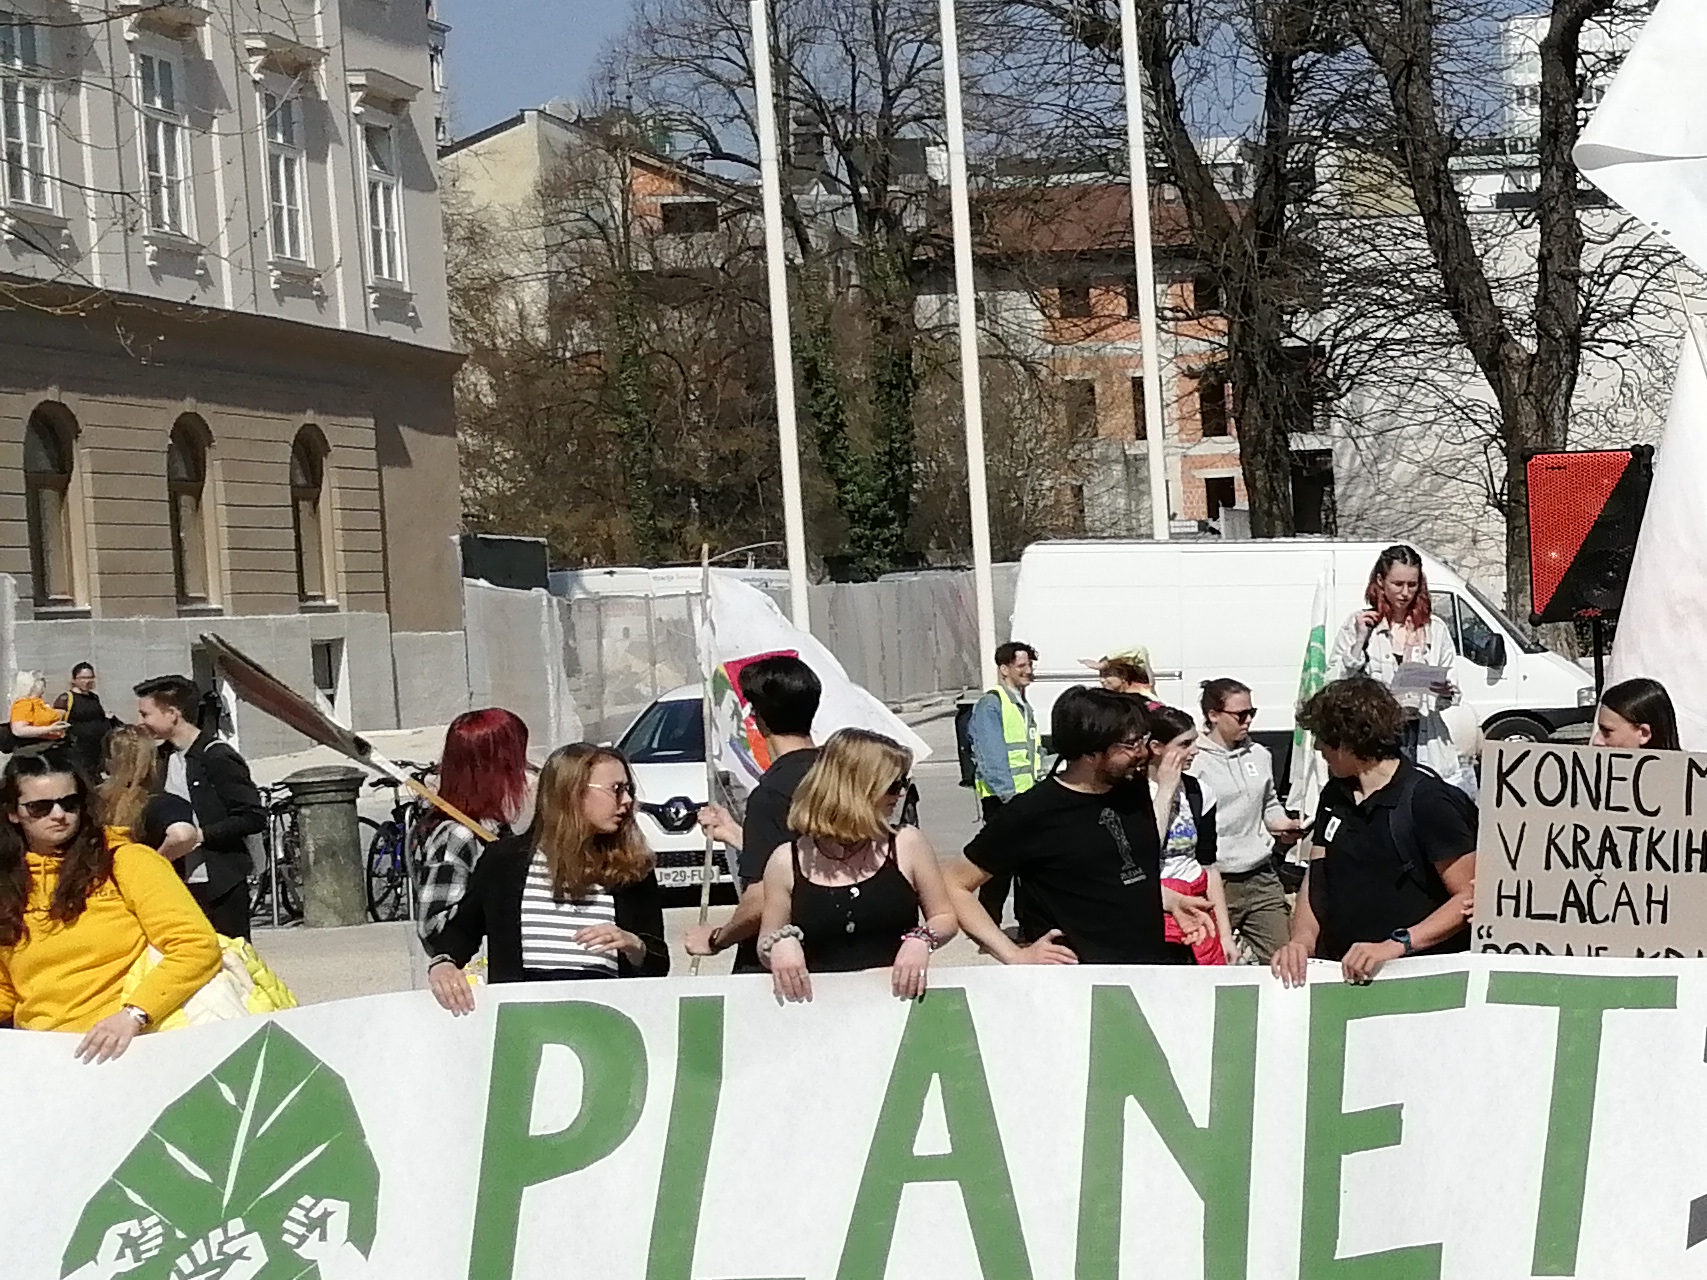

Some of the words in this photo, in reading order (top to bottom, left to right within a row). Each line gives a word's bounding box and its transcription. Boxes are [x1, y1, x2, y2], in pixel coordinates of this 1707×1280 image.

[1494, 747, 1661, 818] KONEC
[1497, 821, 1527, 871] V
[1495, 872, 1669, 926] HLAČAH
